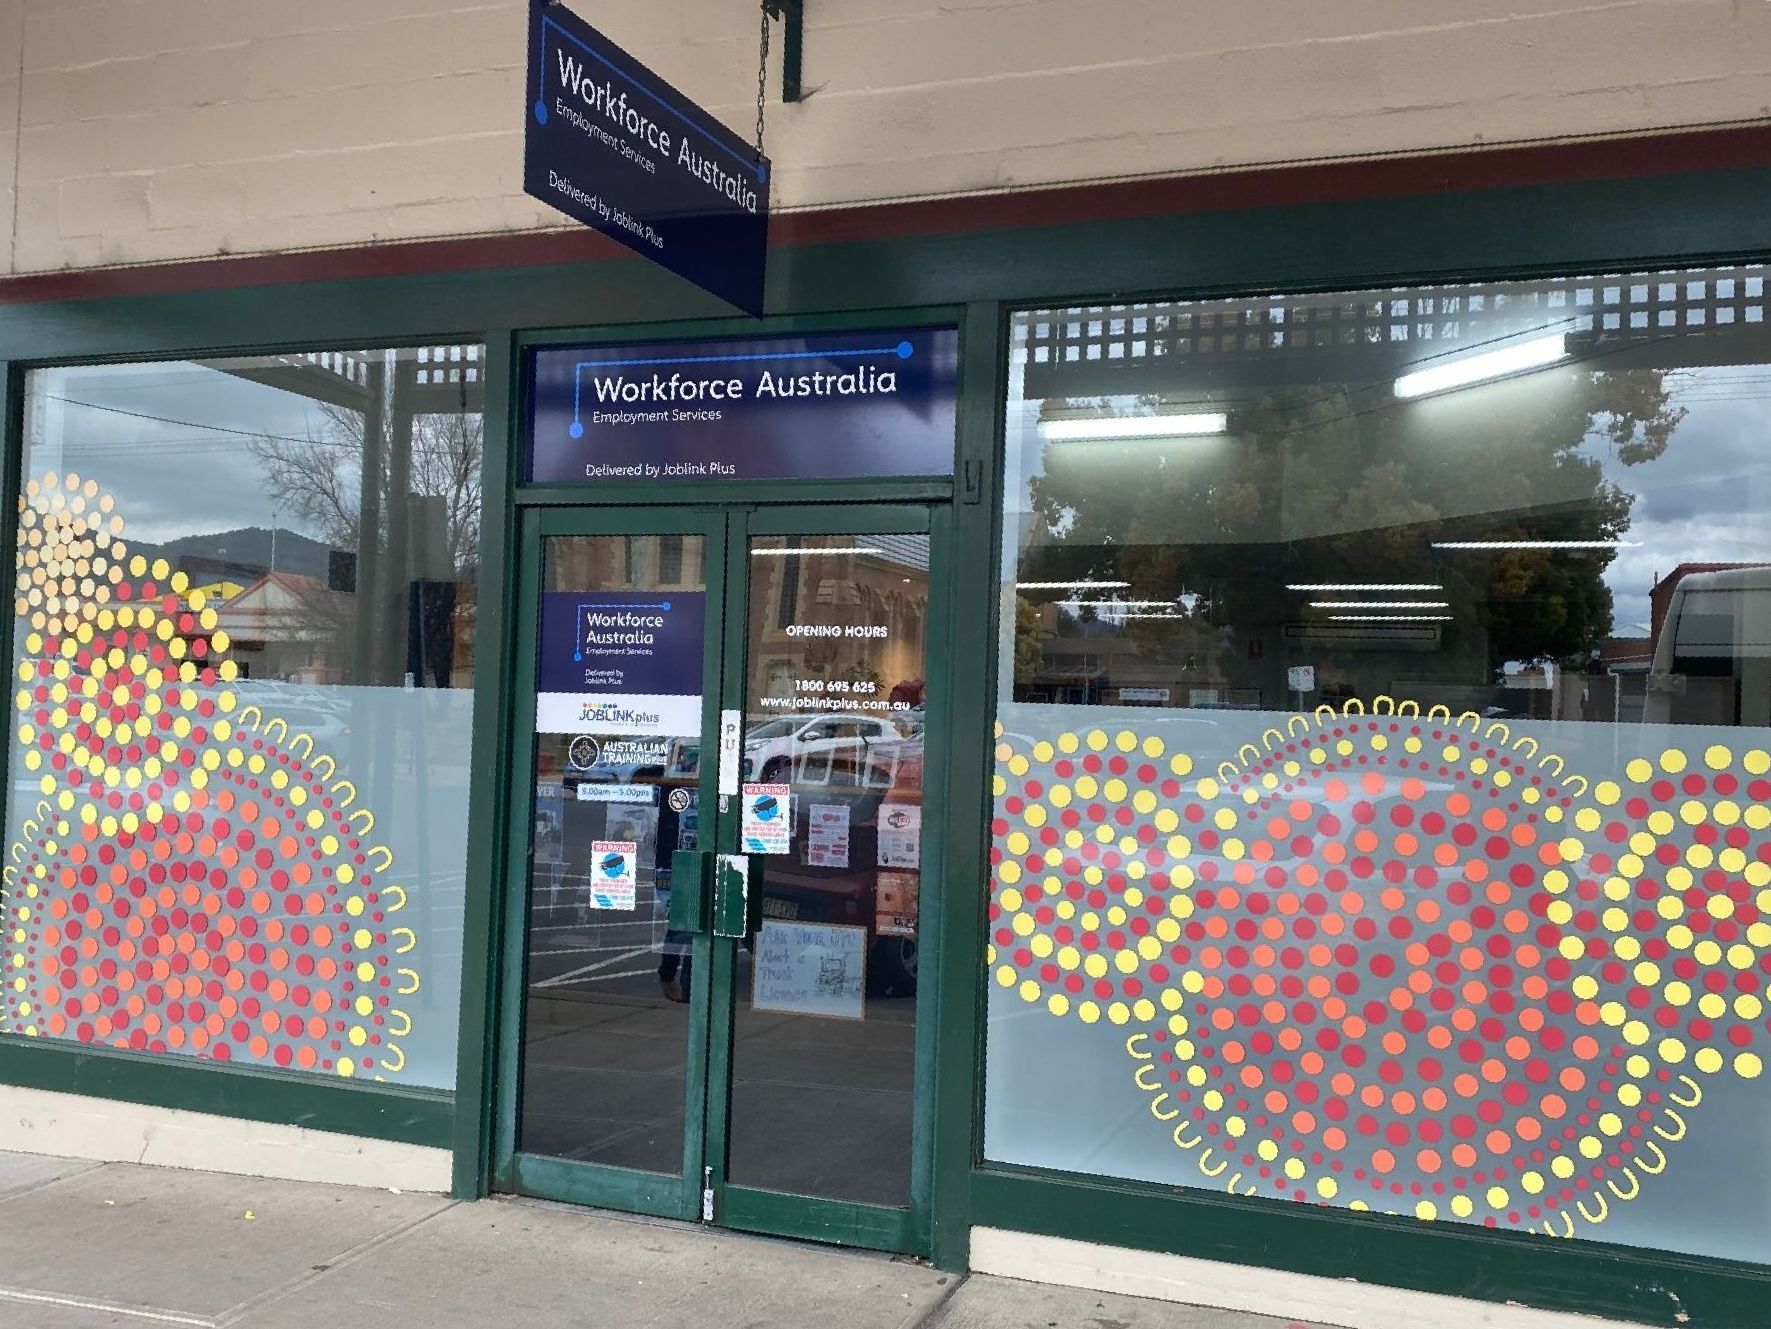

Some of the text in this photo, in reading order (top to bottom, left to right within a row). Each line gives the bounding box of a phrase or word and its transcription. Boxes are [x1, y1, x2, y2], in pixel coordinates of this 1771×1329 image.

[555, 97, 656, 175] Employment Services
[557, 48, 758, 215] Workforce Australia
[549, 169, 665, 250] Delivered by Joblink Plus
[593, 365, 897, 404] Workforce Australia
[592, 408, 722, 425] Employment Services
[585, 462, 736, 477] Delivered by Joblink Plus
[586, 611, 664, 627] Workforce
[586, 629, 654, 645] Australia
[785, 625, 888, 638] OPENING HOURS
[795, 679, 876, 693] 1800 695 625
[760, 697, 911, 711] www.joblinkplus.com.au
[602, 741, 669, 755] AUSTRALIAN
